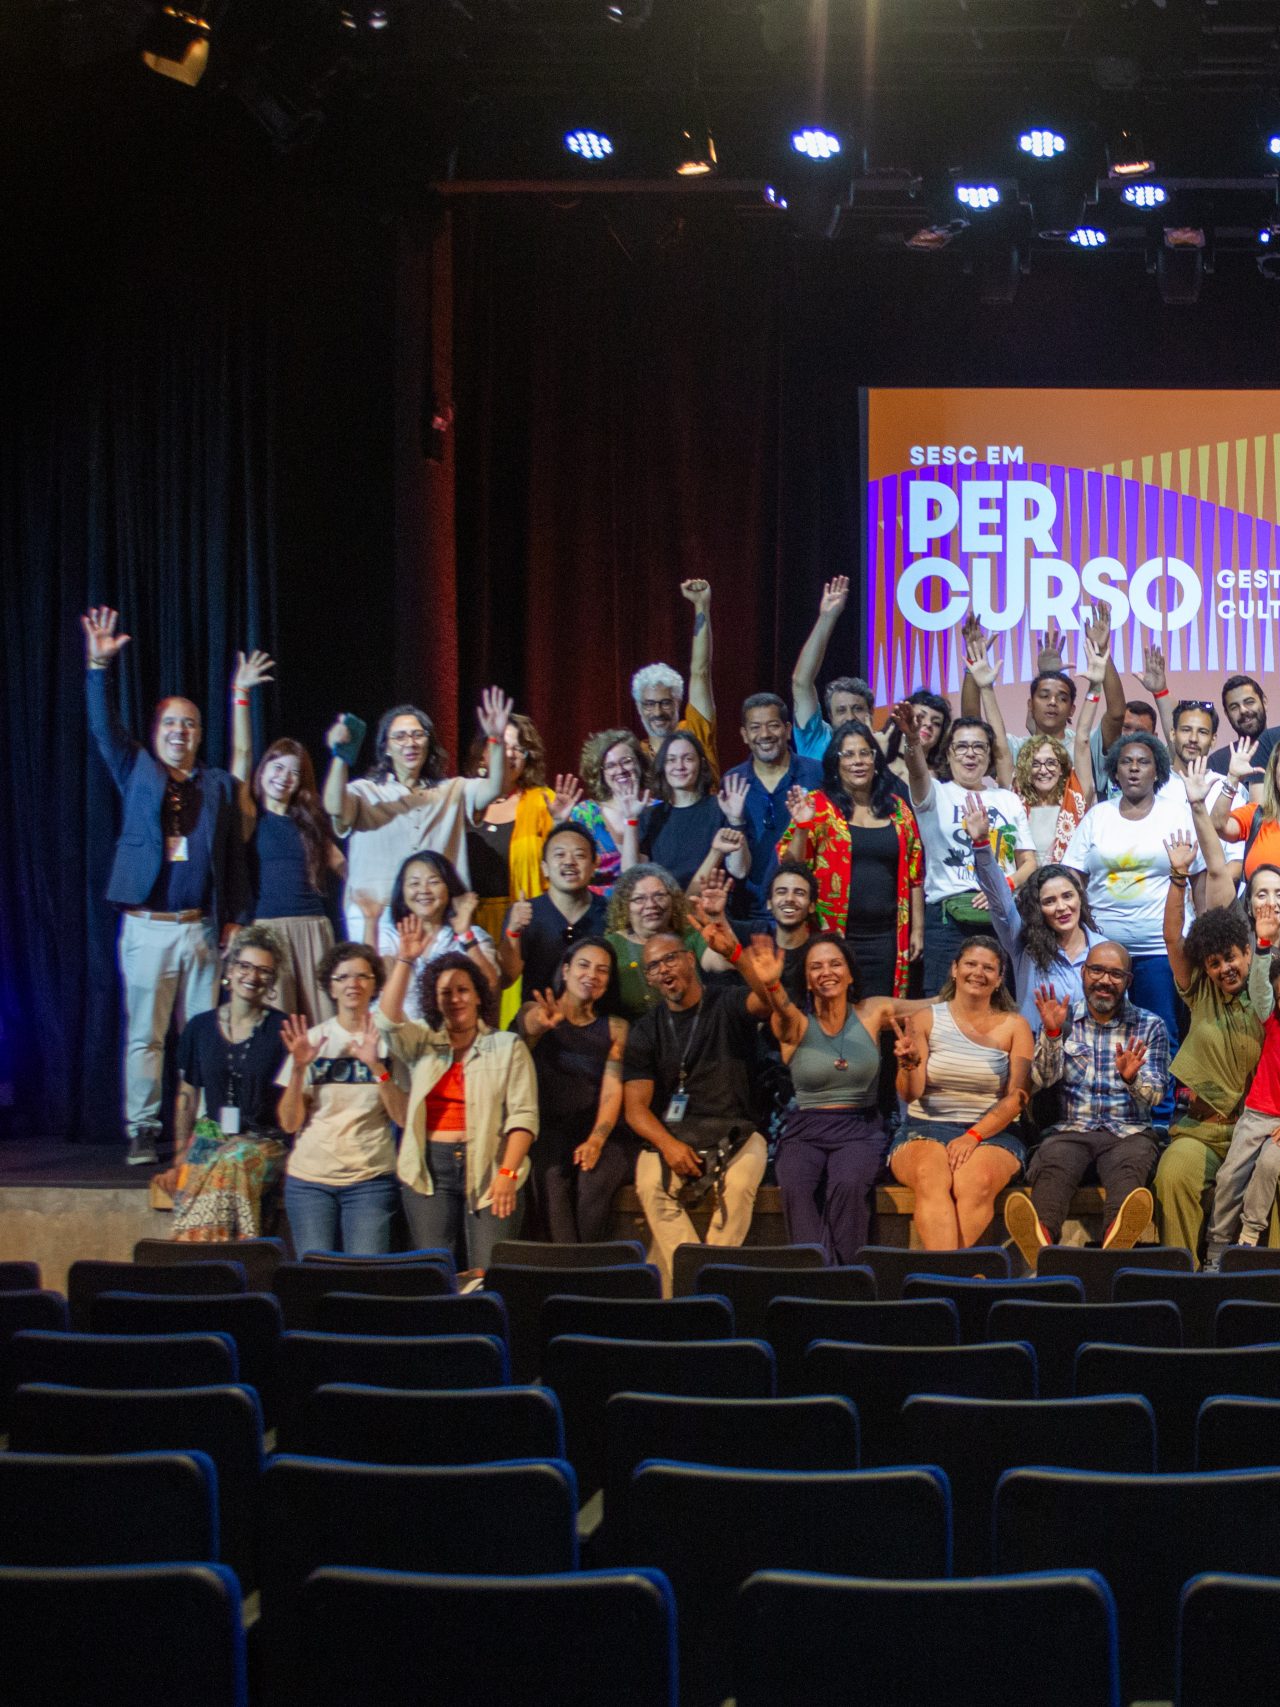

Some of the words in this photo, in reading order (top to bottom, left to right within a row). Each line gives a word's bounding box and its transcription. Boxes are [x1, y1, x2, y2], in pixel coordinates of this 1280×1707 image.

[910, 445, 977, 465] SESC
[987, 446, 1024, 465] EM
[909, 480, 1058, 553] PER
[897, 556, 1202, 632] CURSO
